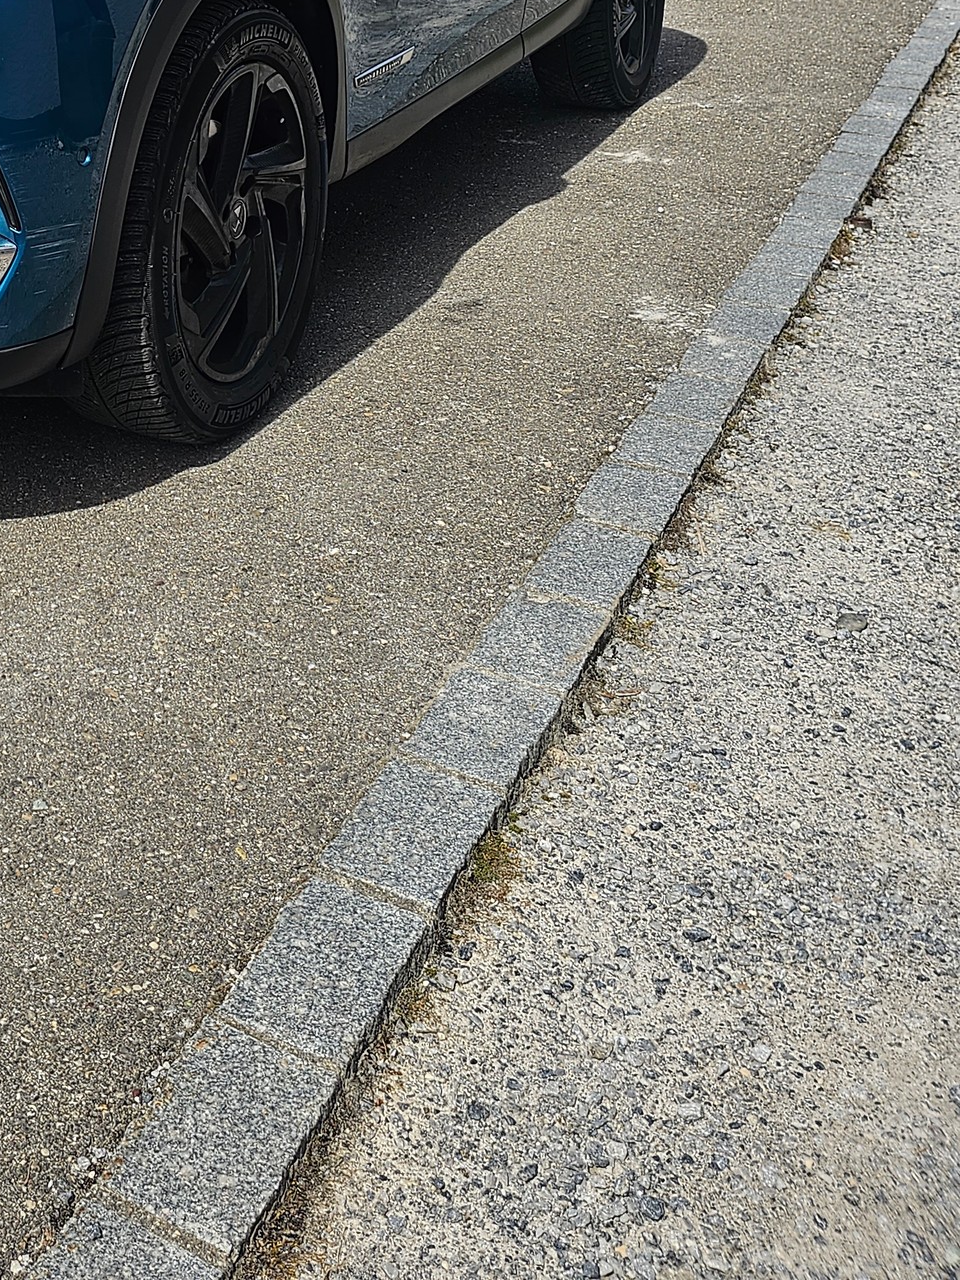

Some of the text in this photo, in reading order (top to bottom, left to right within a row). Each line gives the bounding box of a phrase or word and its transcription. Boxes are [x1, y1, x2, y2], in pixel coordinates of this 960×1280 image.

[240, 23, 291, 46] MICHELIN
[293, 44, 309, 68] PILOT
[179, 368, 188, 381] 18
[214, 386, 271, 424] MICHELIN
